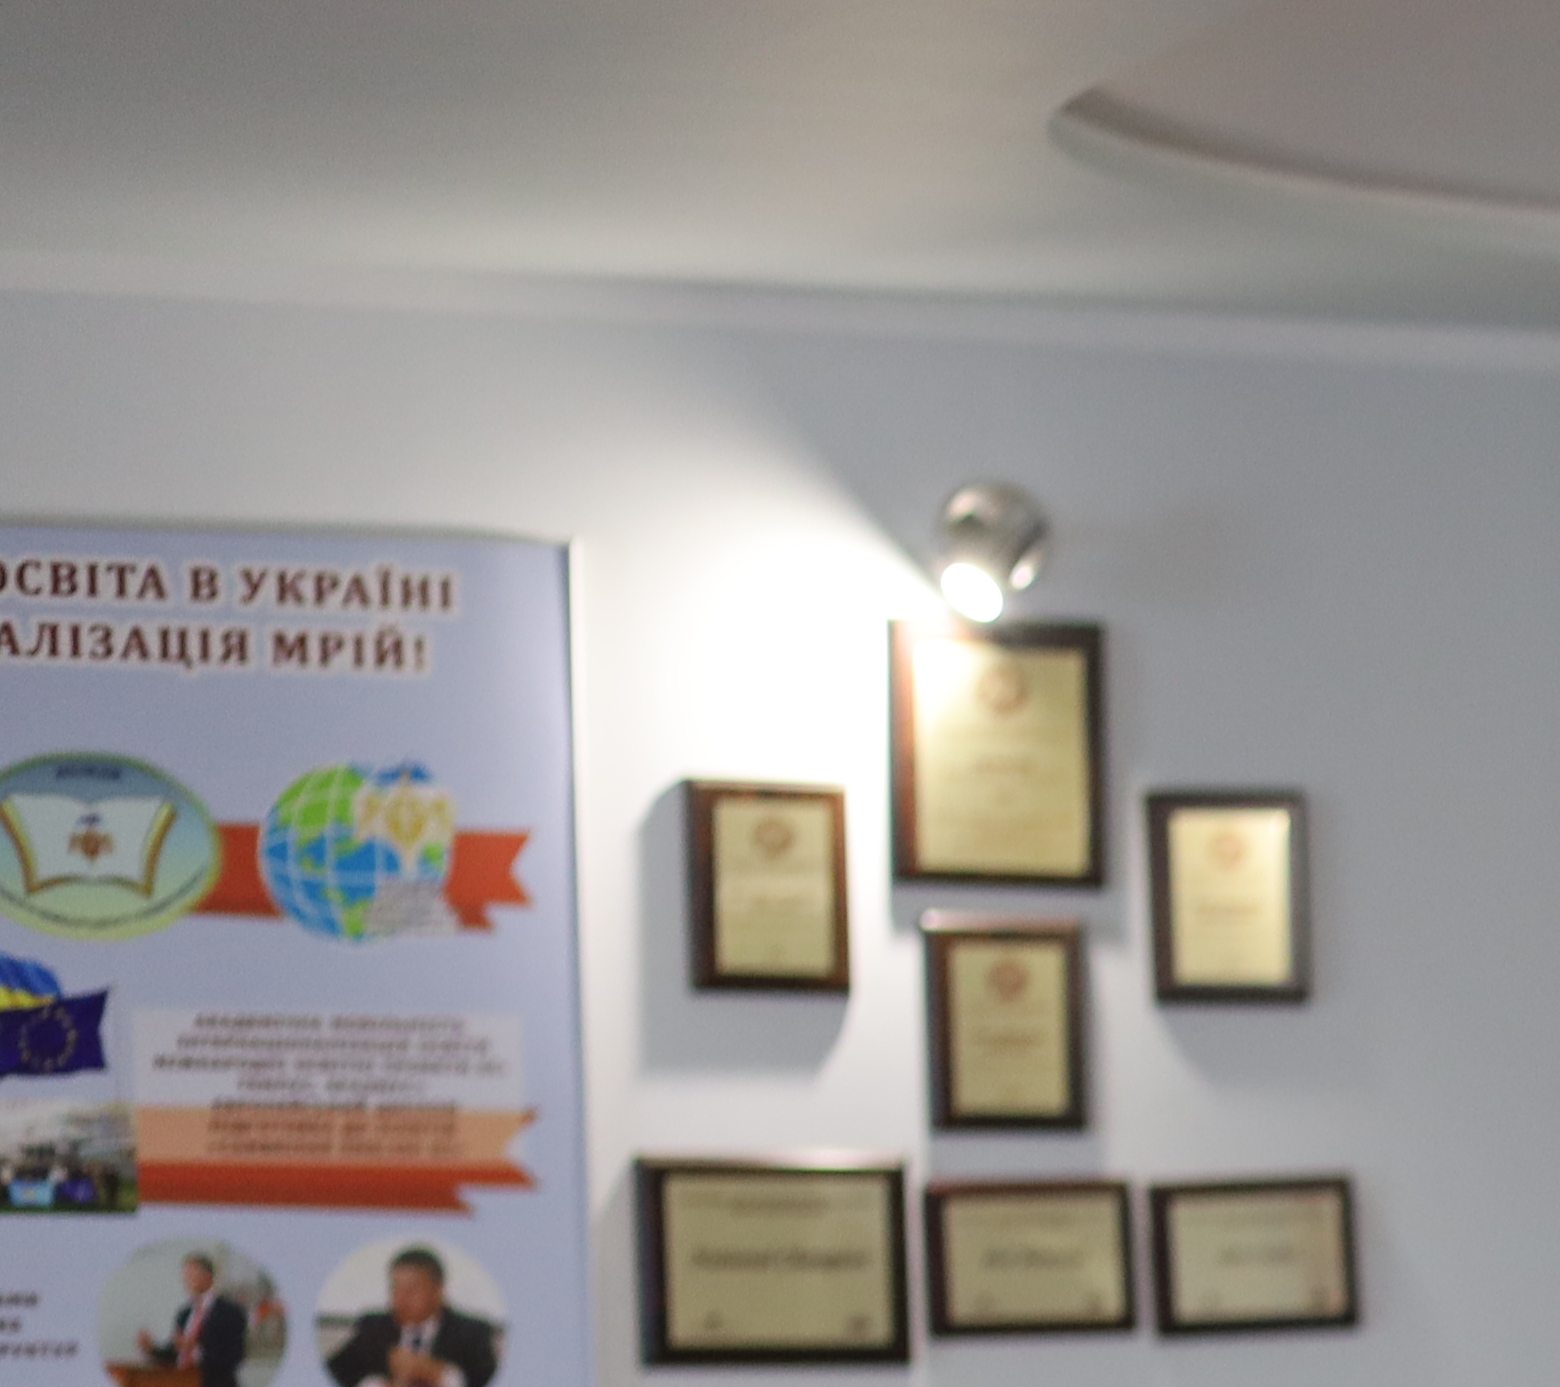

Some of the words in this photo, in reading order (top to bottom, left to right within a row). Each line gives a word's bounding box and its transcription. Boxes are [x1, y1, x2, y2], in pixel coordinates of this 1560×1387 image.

[190, 565, 219, 602] В
[241, 565, 456, 613] УКРАЇНІ
[271, 624, 427, 672] МРІЙ!
